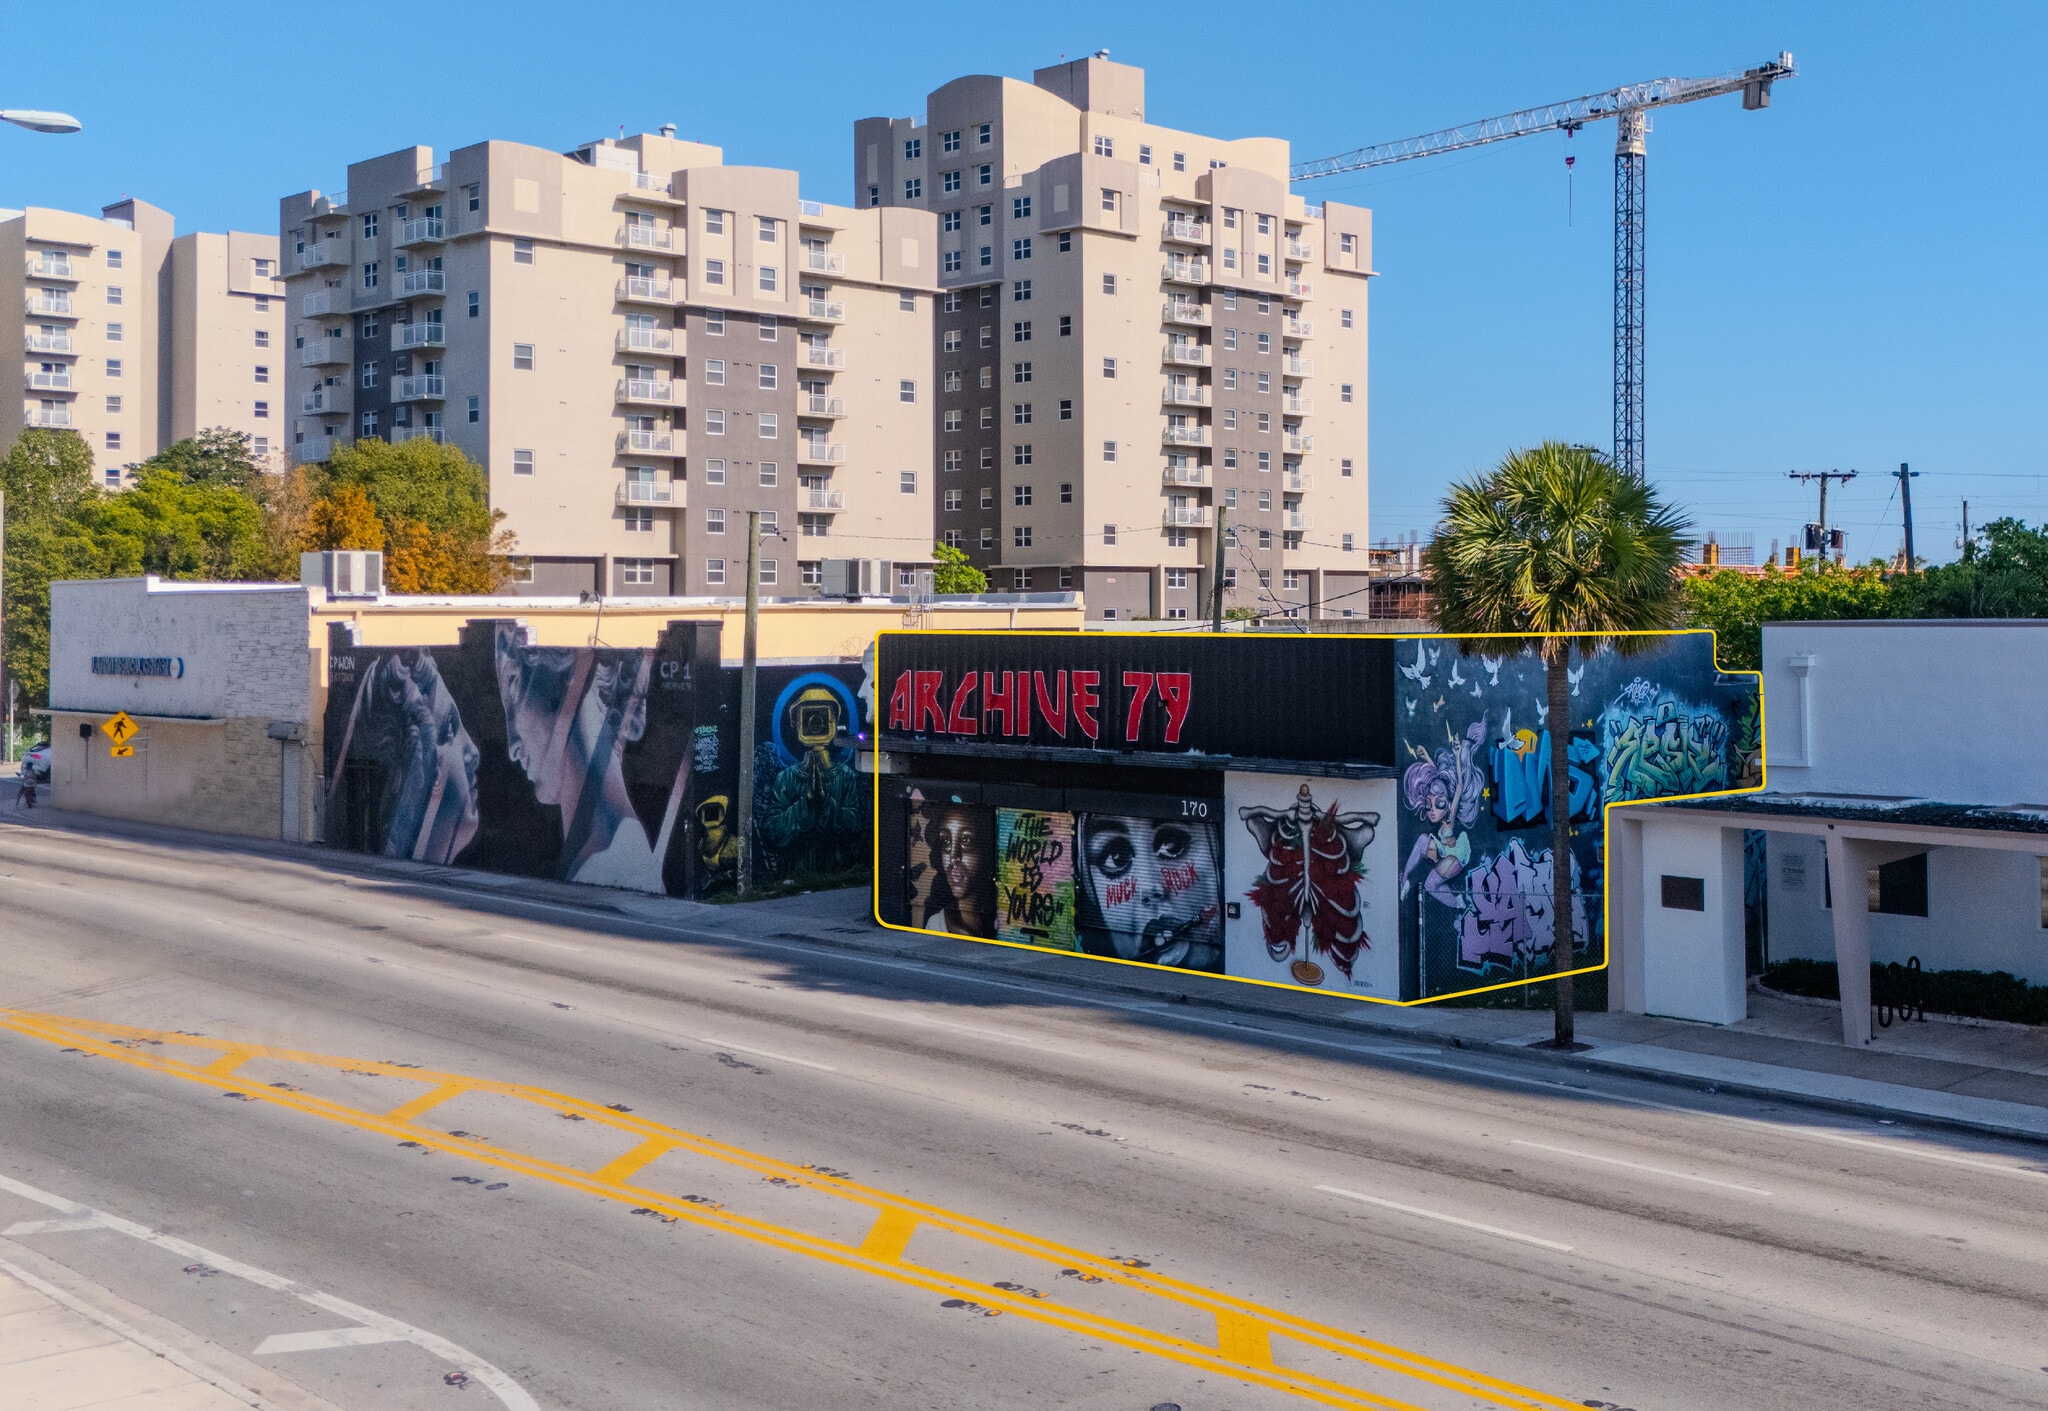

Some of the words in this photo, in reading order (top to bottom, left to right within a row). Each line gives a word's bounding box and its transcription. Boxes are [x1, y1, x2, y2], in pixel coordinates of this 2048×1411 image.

[660, 660, 679, 679] CP
[889, 669, 1100, 740] ARCHIVE
[1123, 670, 1192, 743] 79
[1181, 800, 1208, 818] 170
[1005, 832, 1064, 865] WORLD
